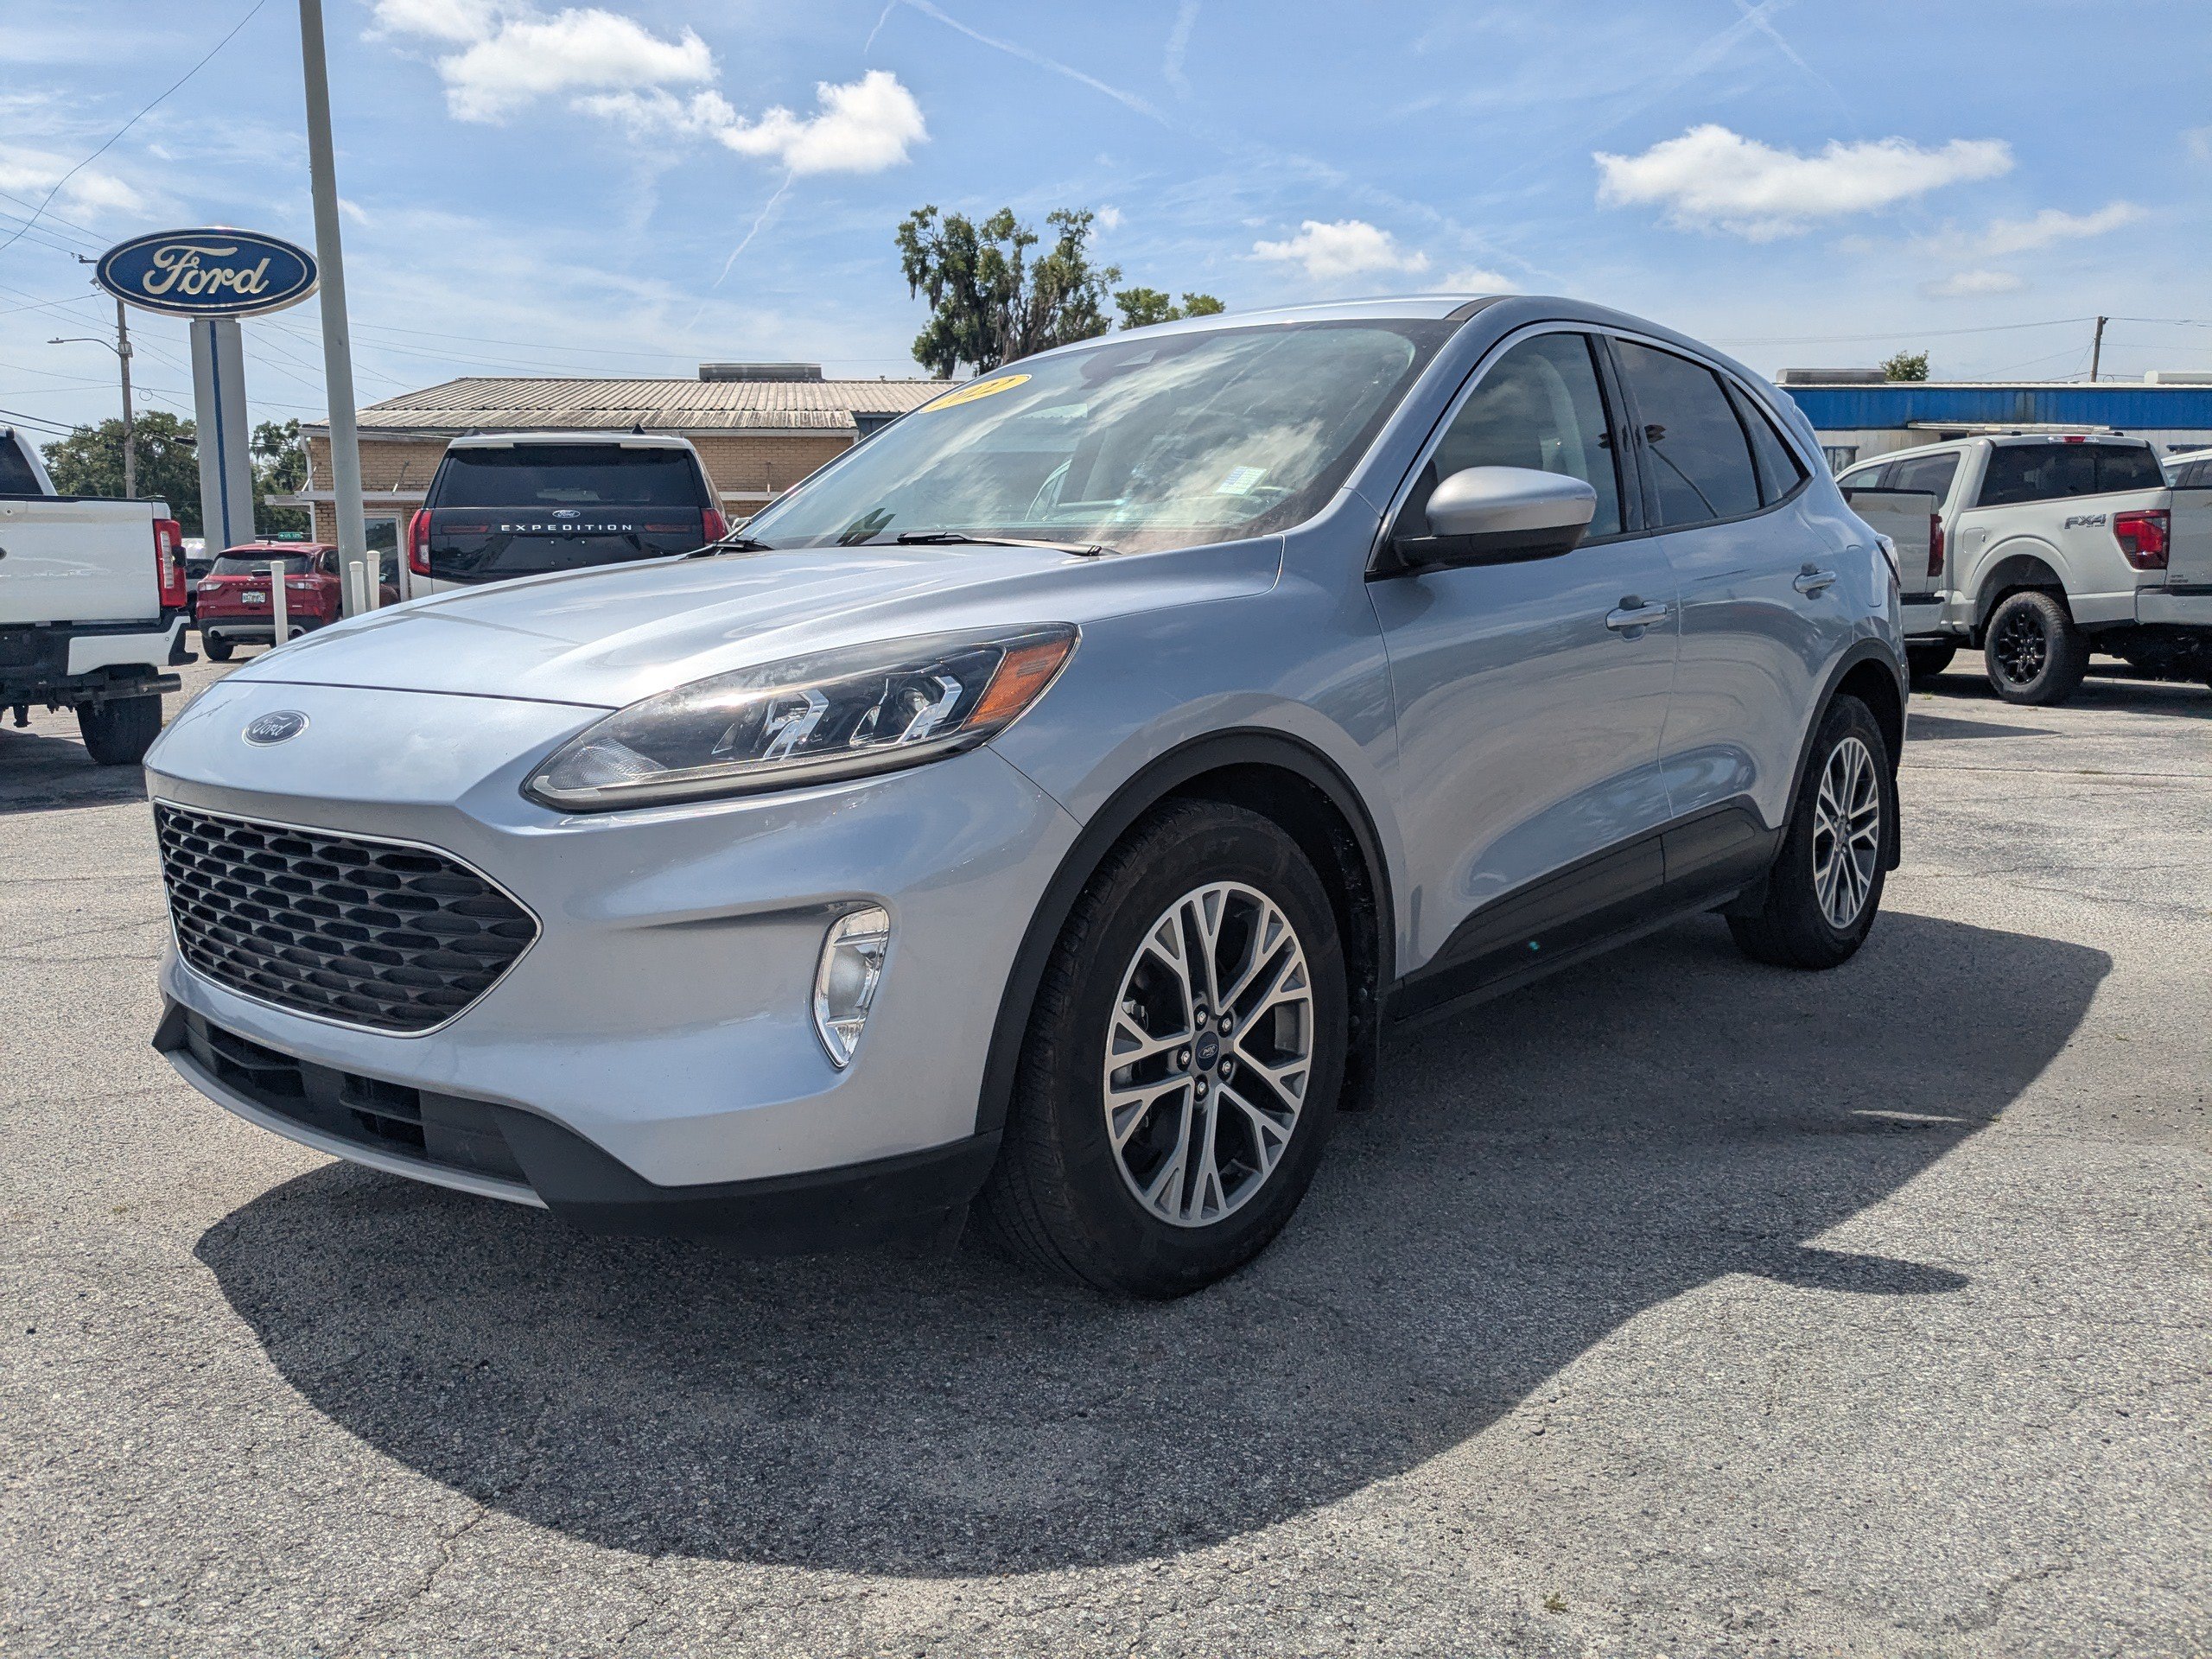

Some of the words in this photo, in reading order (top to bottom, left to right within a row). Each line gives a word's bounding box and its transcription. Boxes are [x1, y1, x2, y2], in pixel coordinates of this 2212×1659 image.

[143, 245, 271, 295] Ford
[2064, 514, 2107, 529] FX4
[251, 715, 292, 736] Ford
